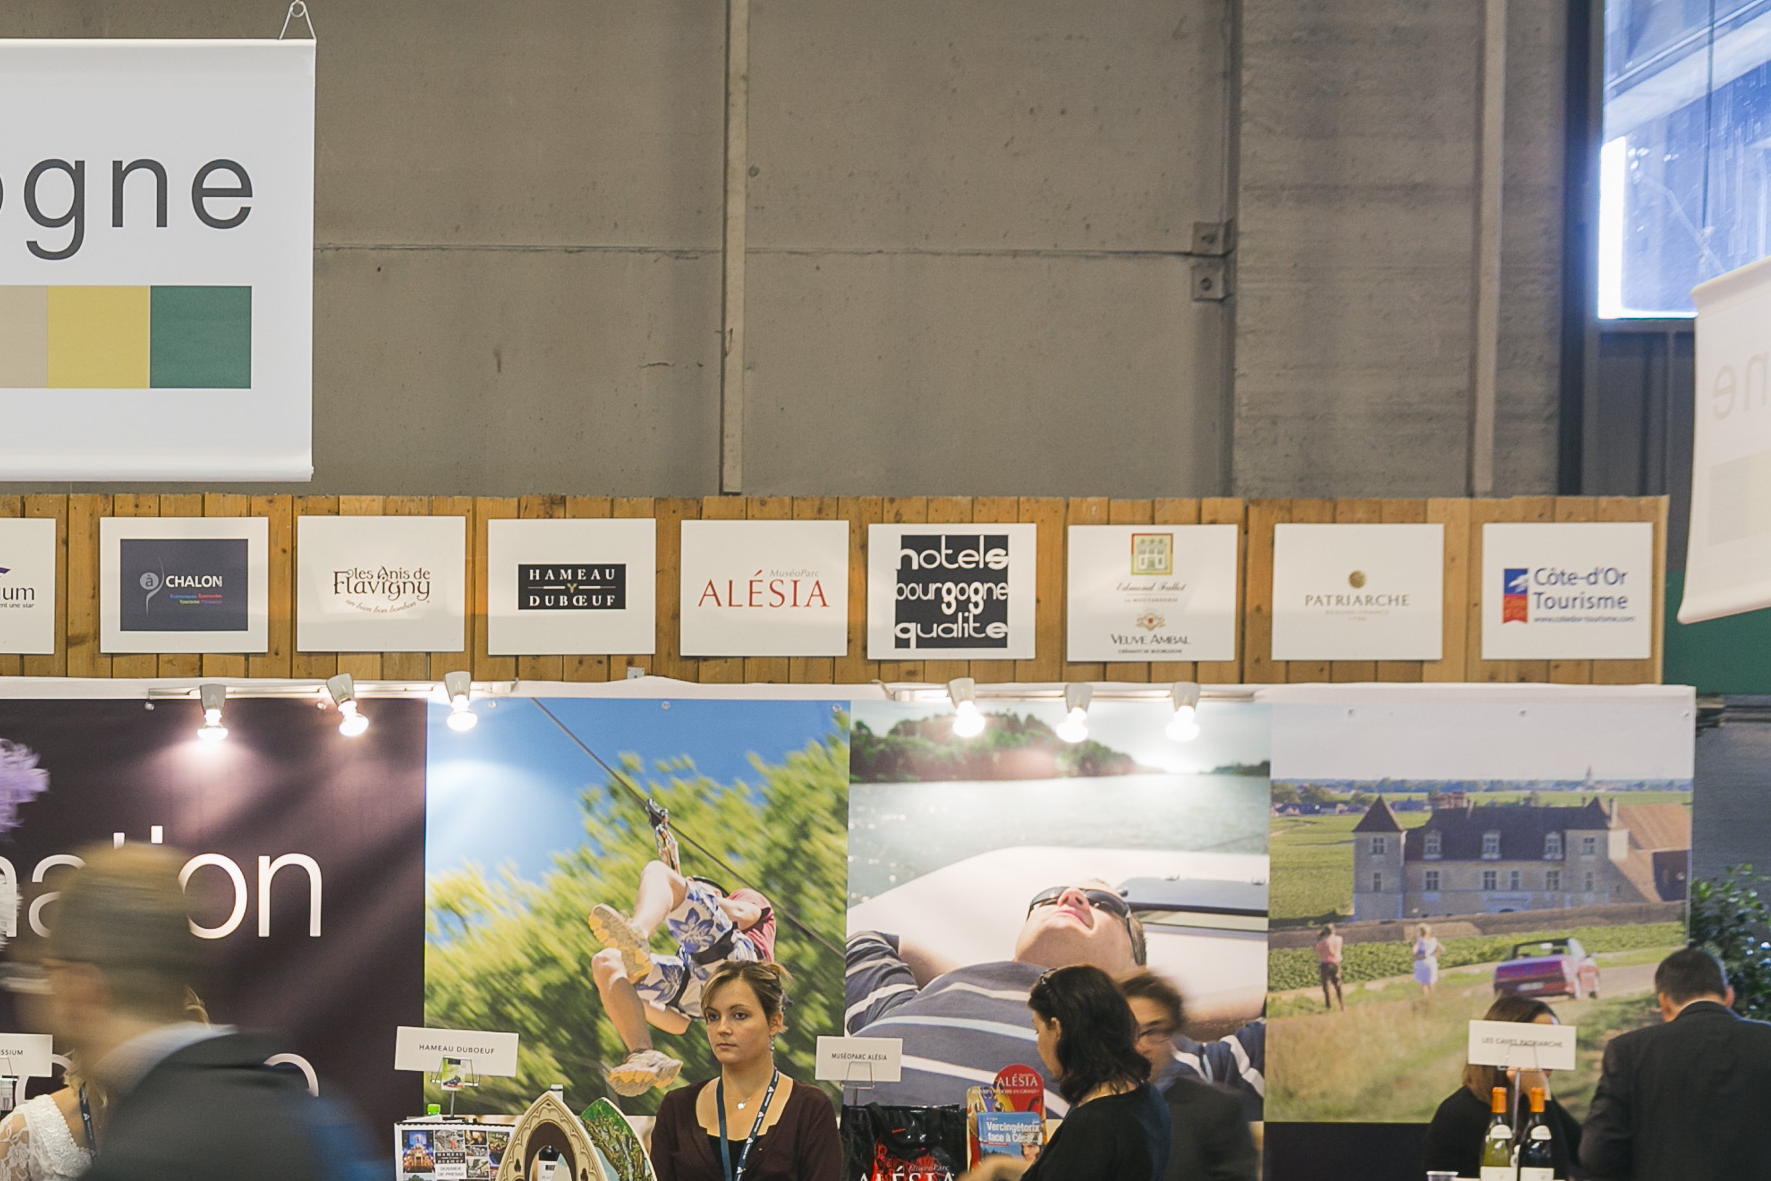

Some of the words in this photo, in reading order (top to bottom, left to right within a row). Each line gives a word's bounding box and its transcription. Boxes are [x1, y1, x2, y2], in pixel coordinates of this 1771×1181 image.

[897, 534, 1008, 570] hotels
[354, 567, 374, 579] les
[377, 566, 410, 581] Anis
[413, 567, 430, 579] de
[529, 569, 615, 580] HAMEAU
[770, 569, 820, 578] MuséoParc
[1534, 567, 1628, 585] Côte-d'Or
[166, 575, 223, 587] CHALON
[334, 568, 431, 601] Flavigny
[698, 570, 829, 608] ALÉSIA
[529, 594, 616, 606] DUBŒUF
[896, 579, 1008, 615] bourgogne
[1305, 595, 1411, 606] PATRIARCHE
[1533, 591, 1628, 609] Tourisme
[895, 611, 1008, 647] qualite
[1111, 634, 1146, 645] VEUVE
[419, 1044, 454, 1052] HAMEAU
[457, 1046, 495, 1054] DUBOEUF
[832, 1052, 866, 1060] MUSÉOPARC
[868, 1053, 888, 1061] ALÉSIA
[998, 1074, 1039, 1087] ALÉSIA
[986, 1121, 1040, 1133] Vercingétorix
[988, 1132, 1004, 1141] face
